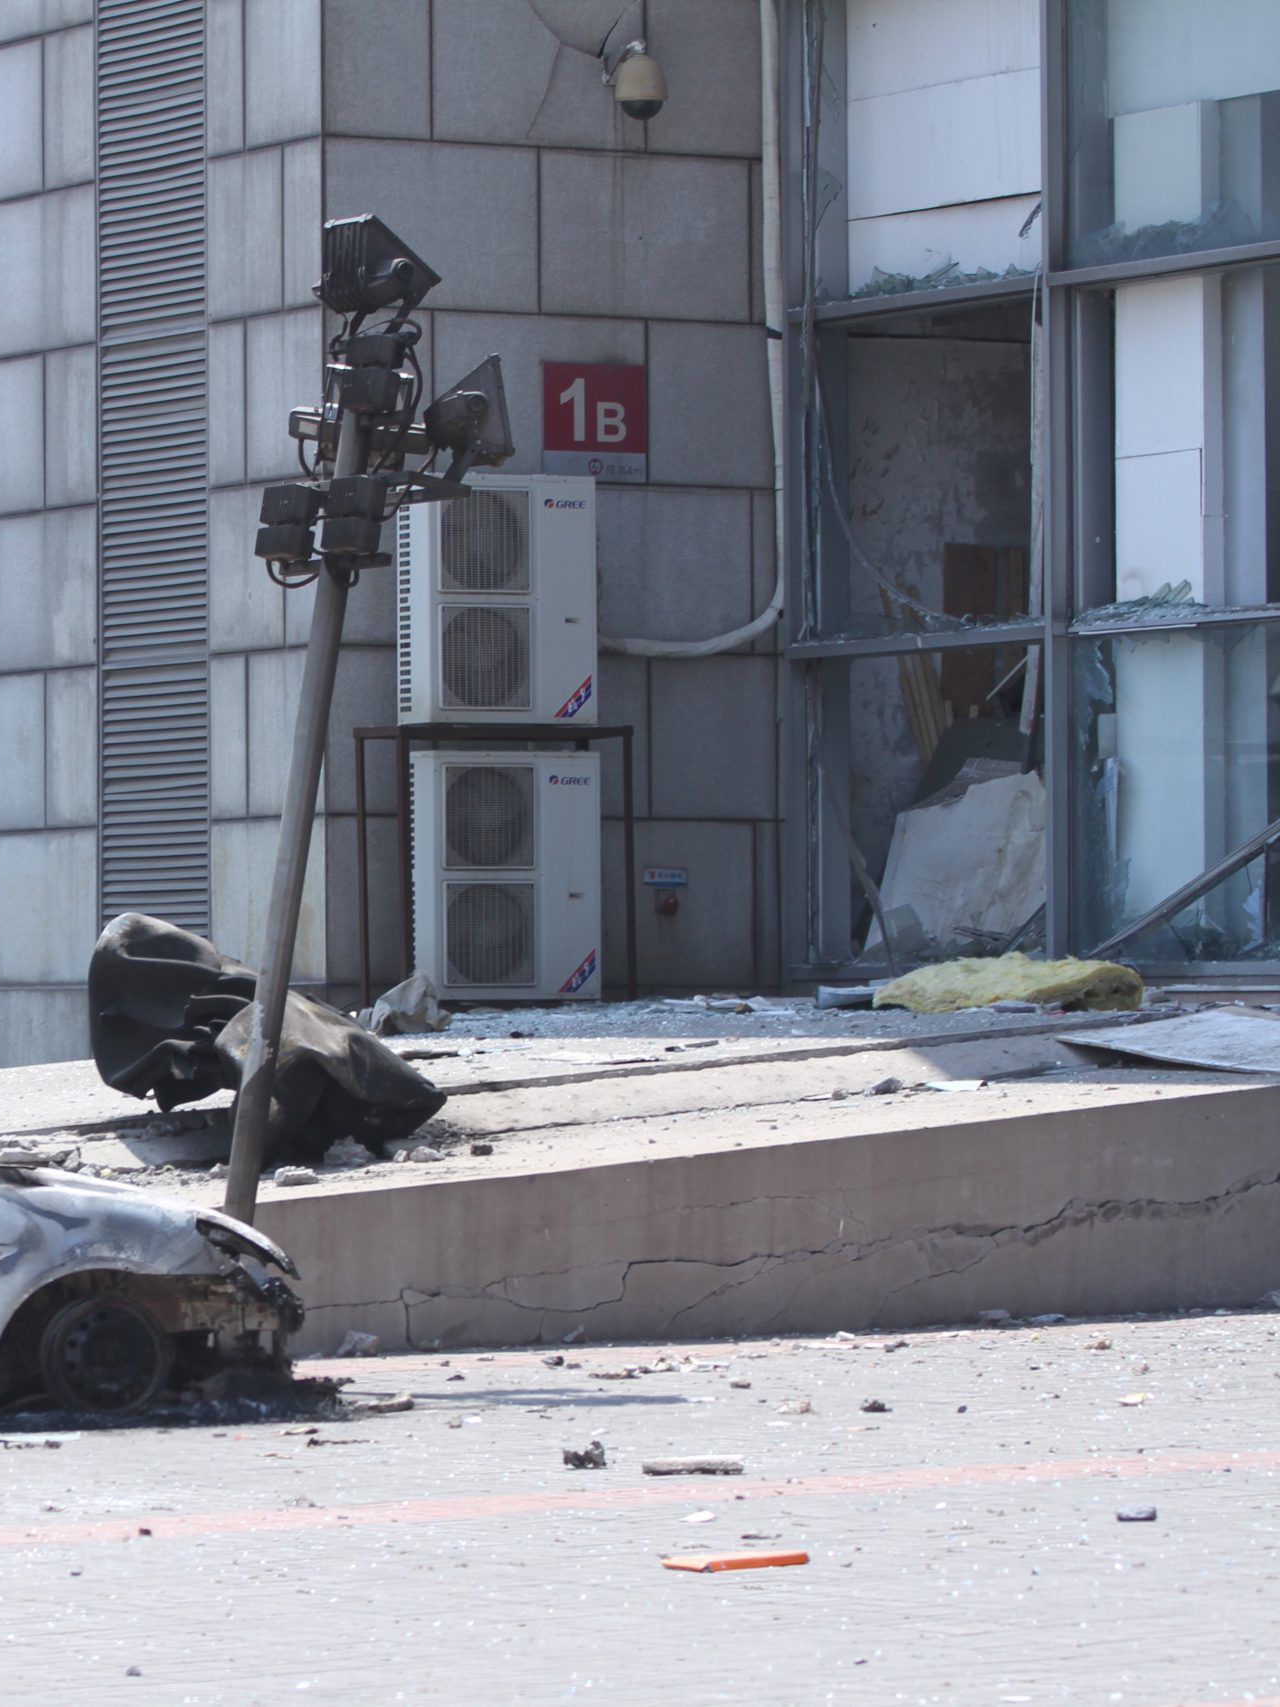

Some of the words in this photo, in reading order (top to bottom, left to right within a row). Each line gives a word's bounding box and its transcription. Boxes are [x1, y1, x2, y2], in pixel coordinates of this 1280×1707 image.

[560, 378, 627, 443] 1B
[556, 499, 587, 510] GREE
[560, 776, 592, 786] GREE
